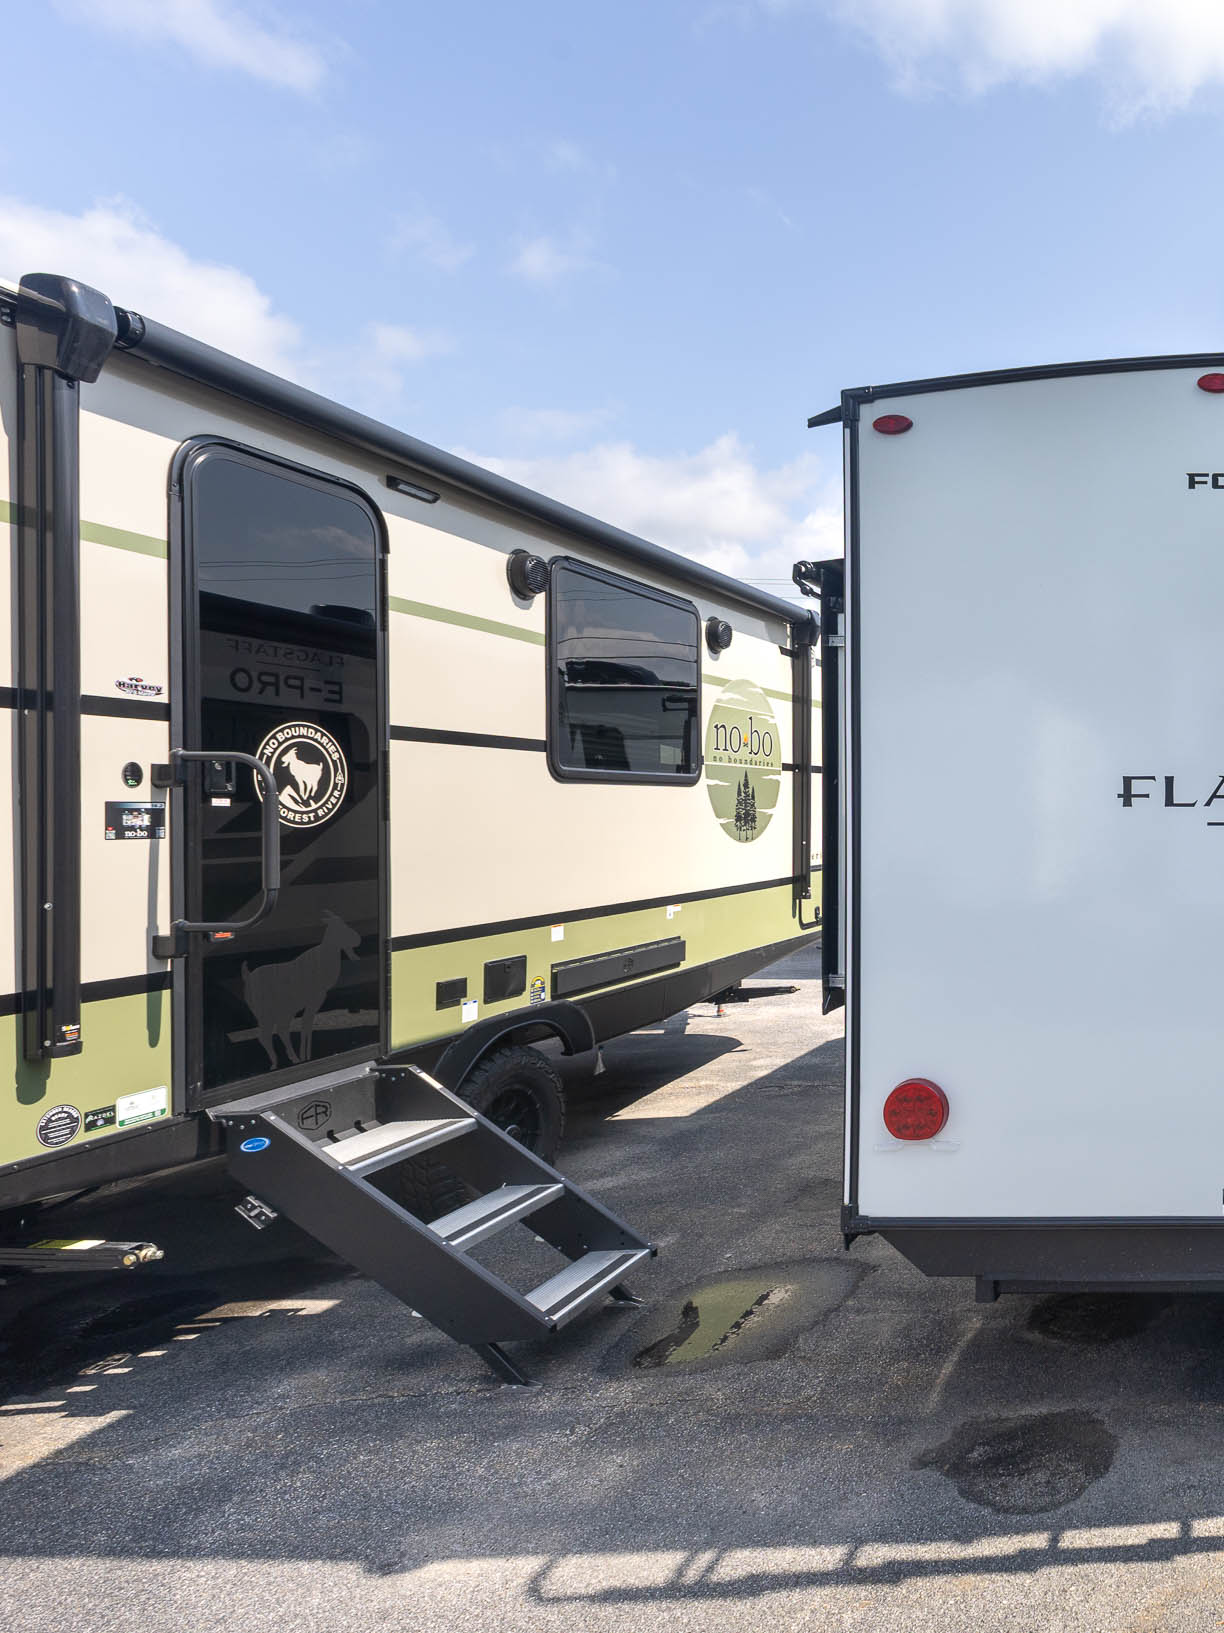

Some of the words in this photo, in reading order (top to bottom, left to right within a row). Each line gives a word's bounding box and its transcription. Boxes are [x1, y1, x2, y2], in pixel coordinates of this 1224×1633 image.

[263, 739, 278, 757] NO
[276, 727, 340, 761] BOUNDARIES
[317, 789, 341, 817] RIVER
